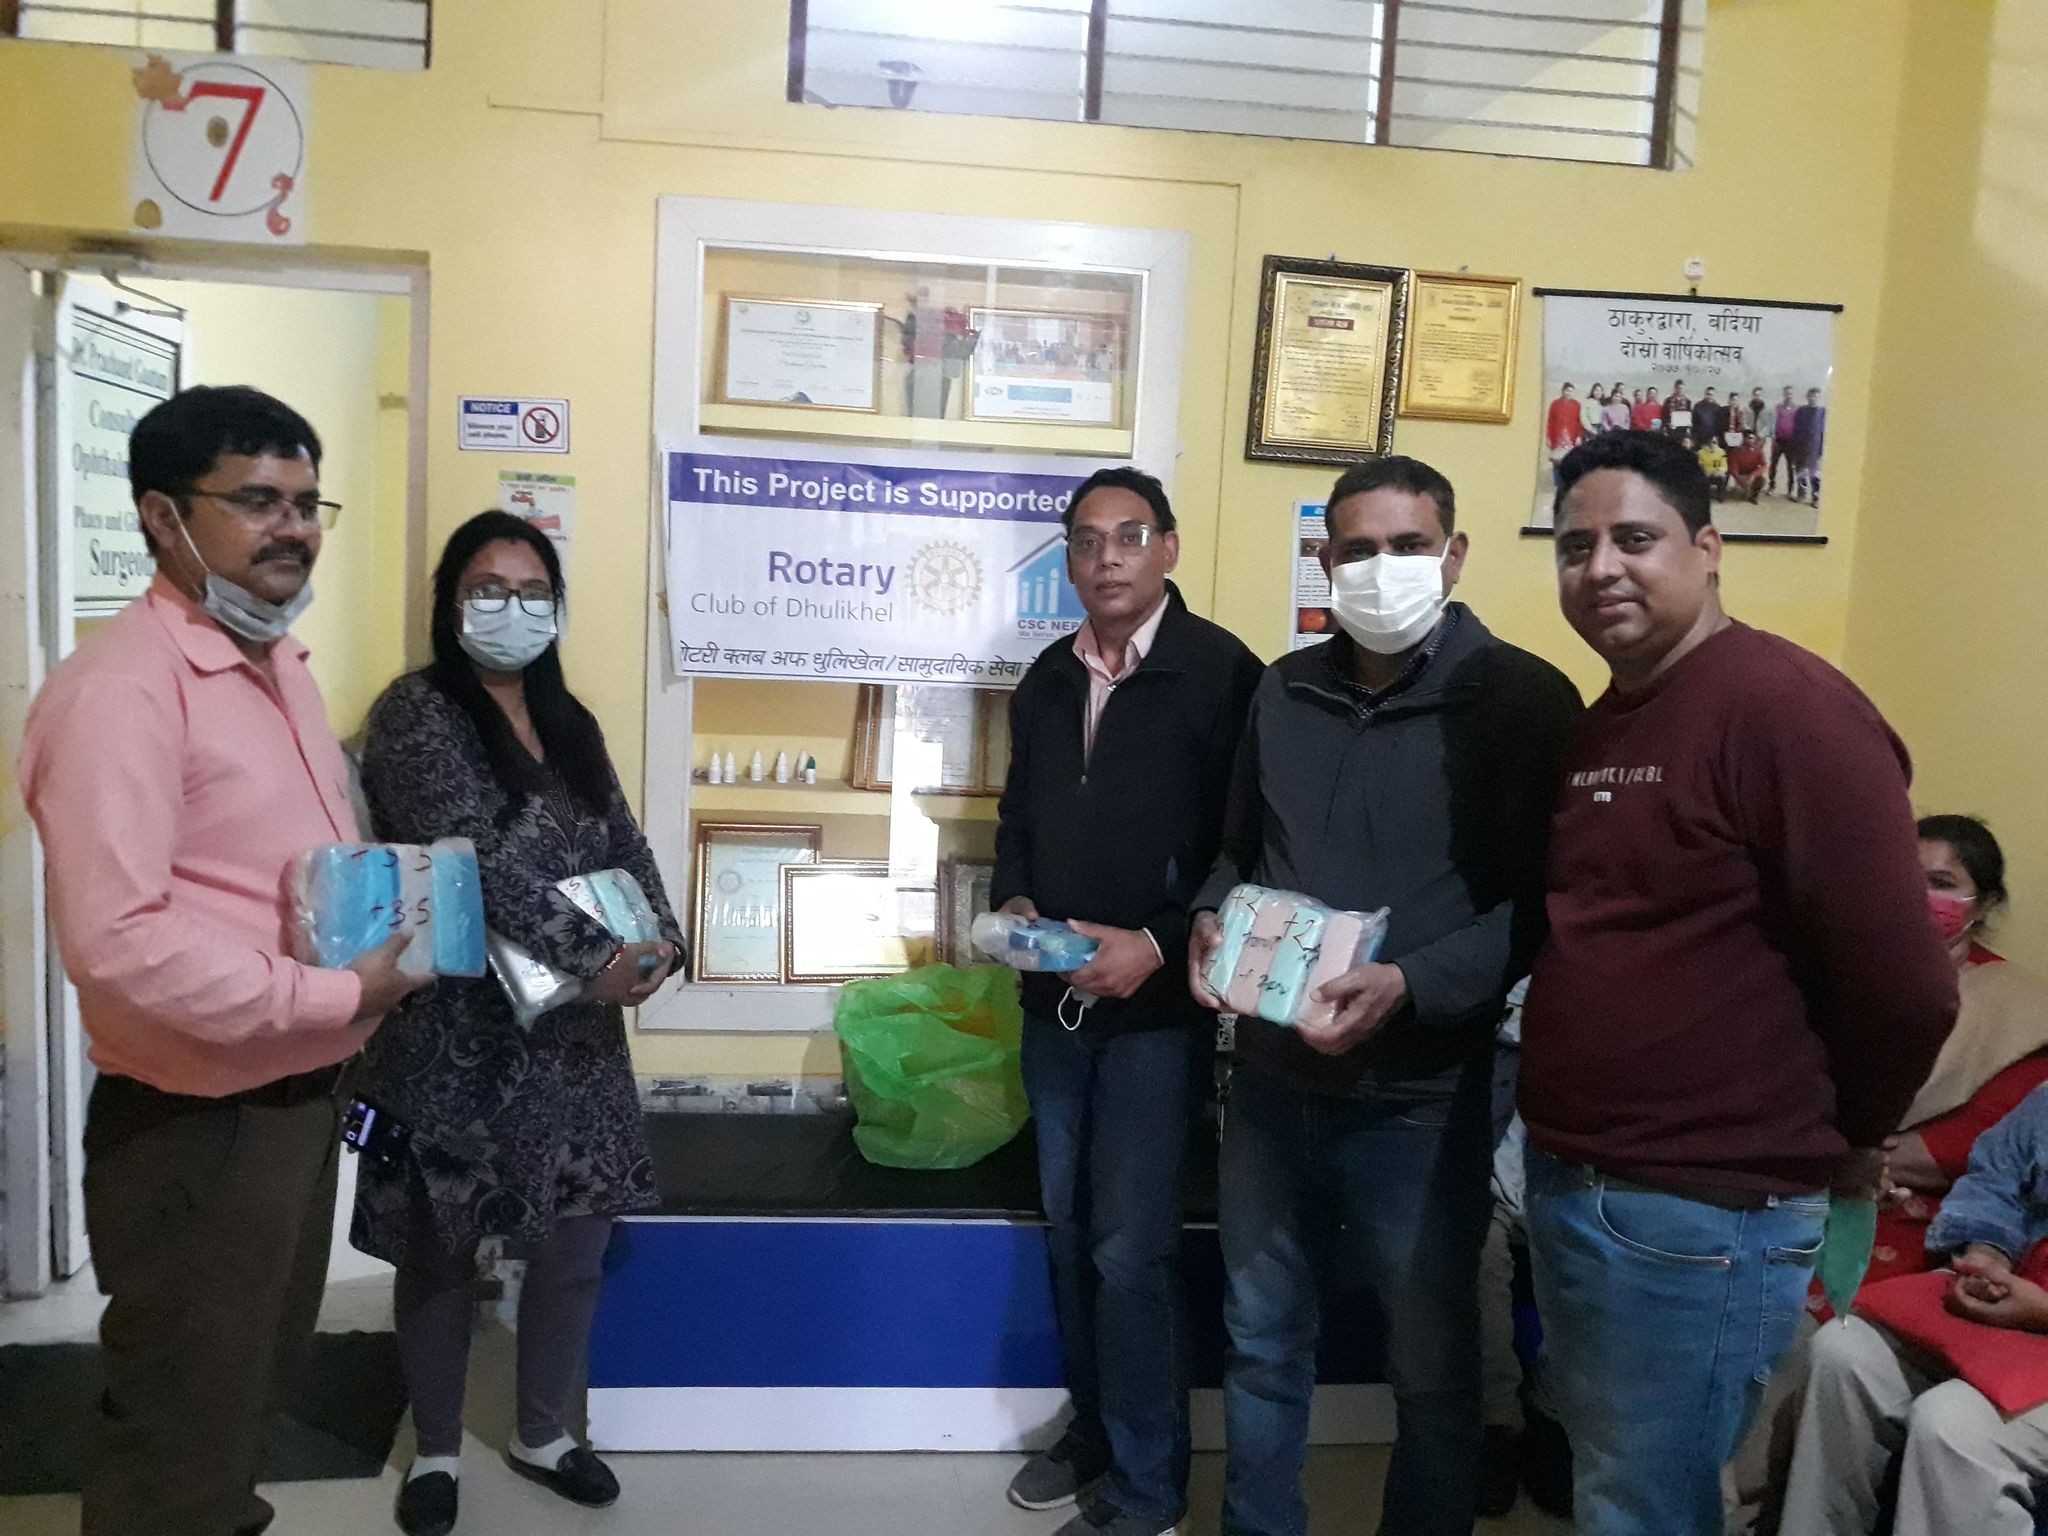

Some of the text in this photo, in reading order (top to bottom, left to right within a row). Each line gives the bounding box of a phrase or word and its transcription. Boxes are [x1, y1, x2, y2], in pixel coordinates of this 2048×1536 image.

[161, 80, 266, 203] 7
[470, 402, 512, 414] NOTICE
[692, 467, 1072, 515] This Project is Supported
[768, 550, 895, 595] Rotary
[691, 593, 893, 622] Club of Dhulikhel
[1018, 619, 1079, 631] CSC NEP
[724, 649, 767, 665] क्लब
[771, 650, 809, 666] अफ
[988, 655, 1023, 676] सेवा
